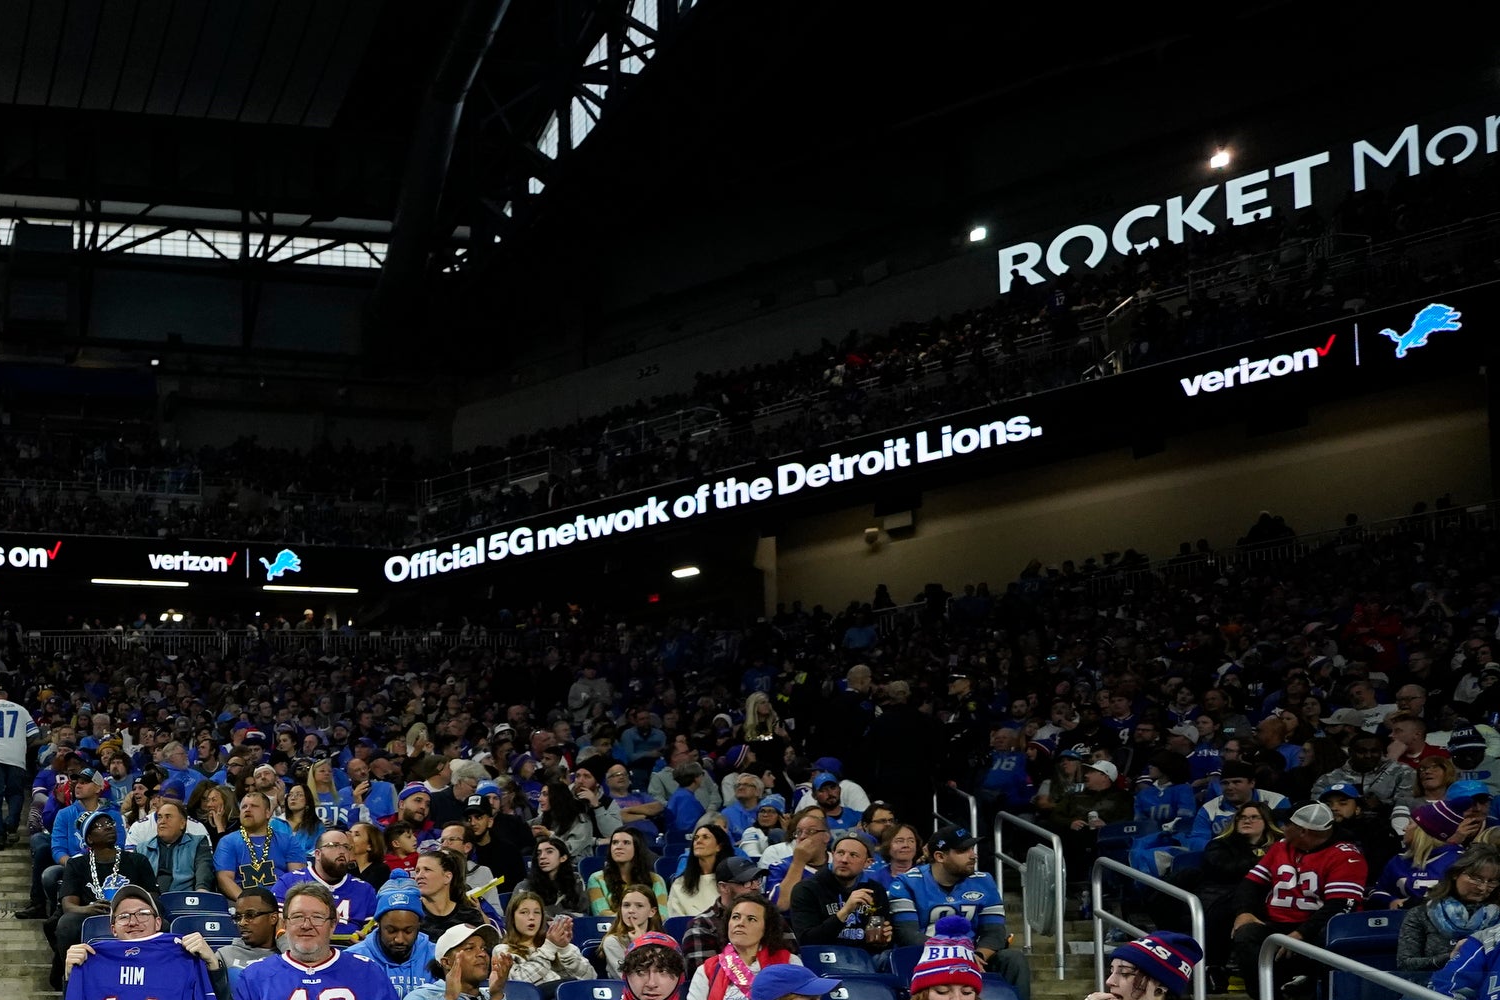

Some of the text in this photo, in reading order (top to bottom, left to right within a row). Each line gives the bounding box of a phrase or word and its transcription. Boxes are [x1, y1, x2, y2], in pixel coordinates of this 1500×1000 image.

[998, 151, 1330, 294] ROCKET
[1179, 348, 1319, 397] verizon
[384, 415, 1043, 583] Official 5G network of the Detroit Lions.
[8, 546, 48, 568] on
[148, 550, 228, 573] verizon
[238, 859, 278, 889] M
[1269, 864, 1324, 911] 23
[119, 965, 146, 986] HIM
[390, 975, 427, 986] TROIT
